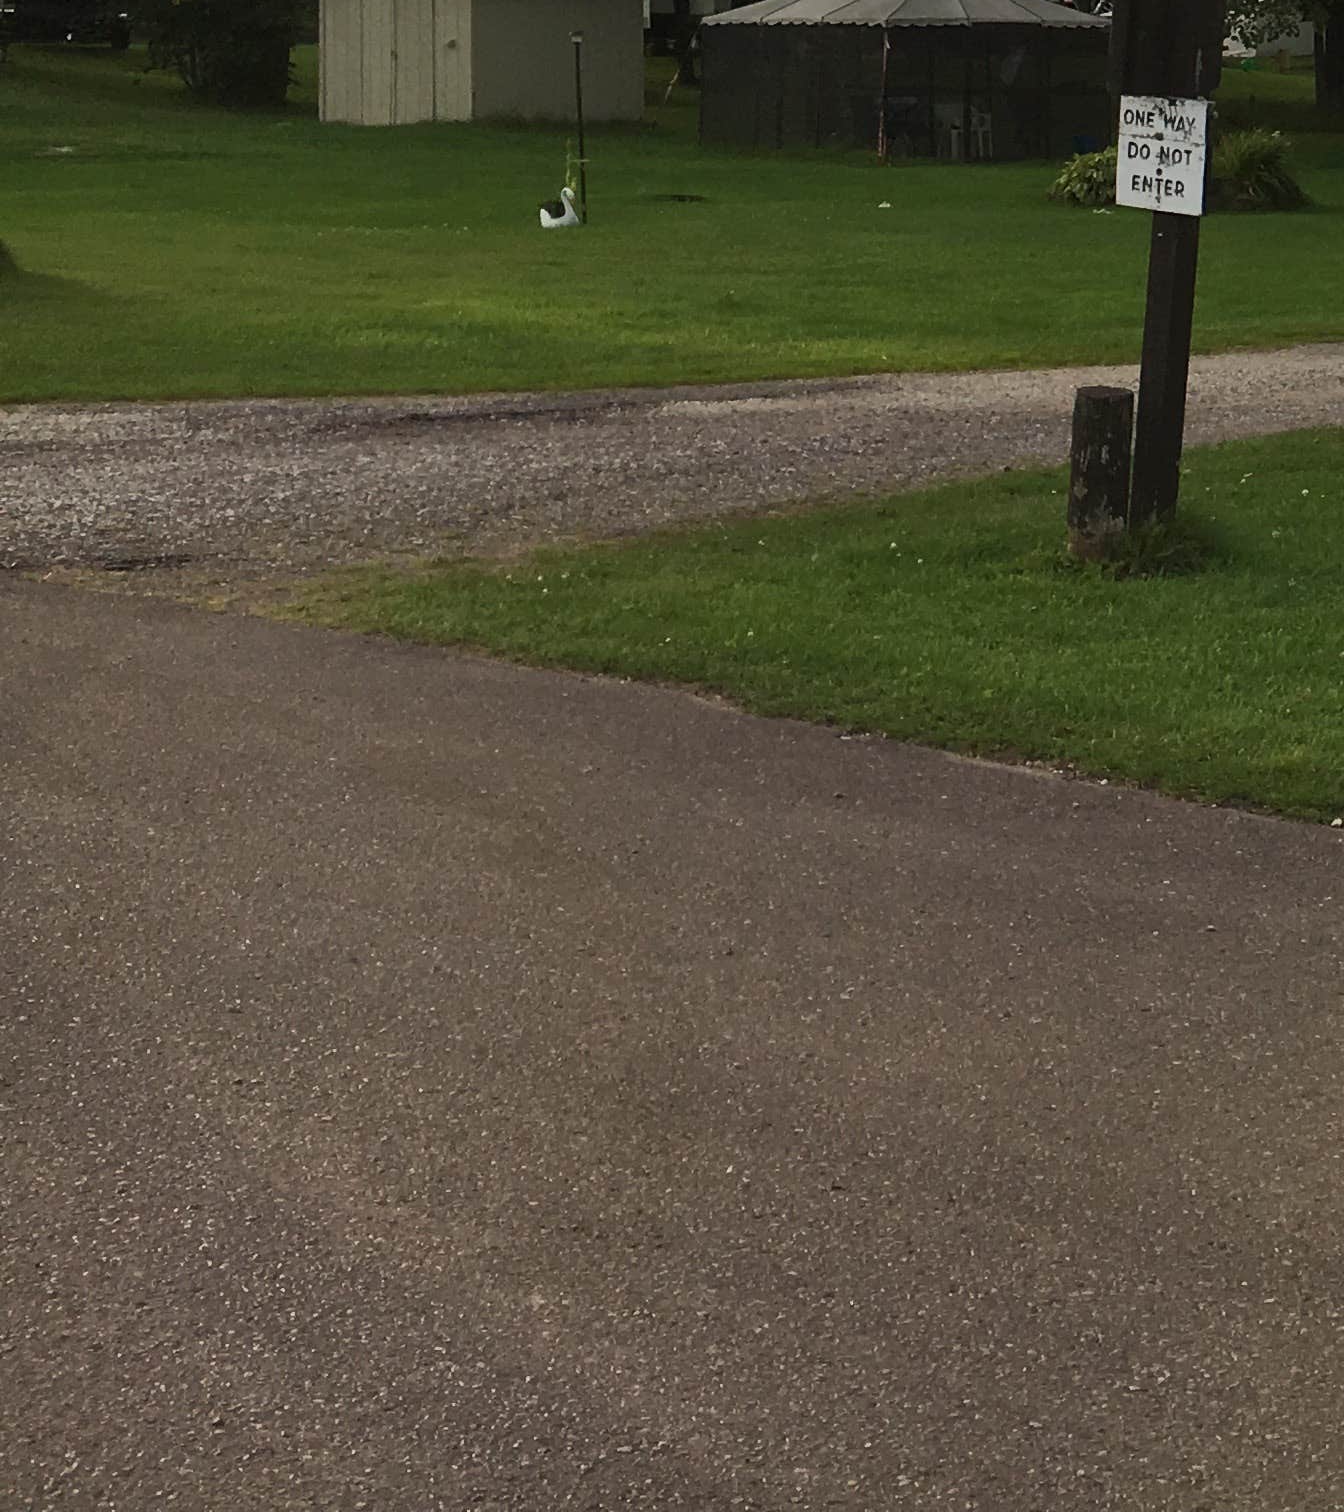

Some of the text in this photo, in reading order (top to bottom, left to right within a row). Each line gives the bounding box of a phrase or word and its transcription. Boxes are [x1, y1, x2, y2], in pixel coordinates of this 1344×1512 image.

[1123, 109, 1196, 132] ONE WAY
[1128, 141, 1192, 165] DO NOT
[1132, 174, 1185, 198] ENTER
